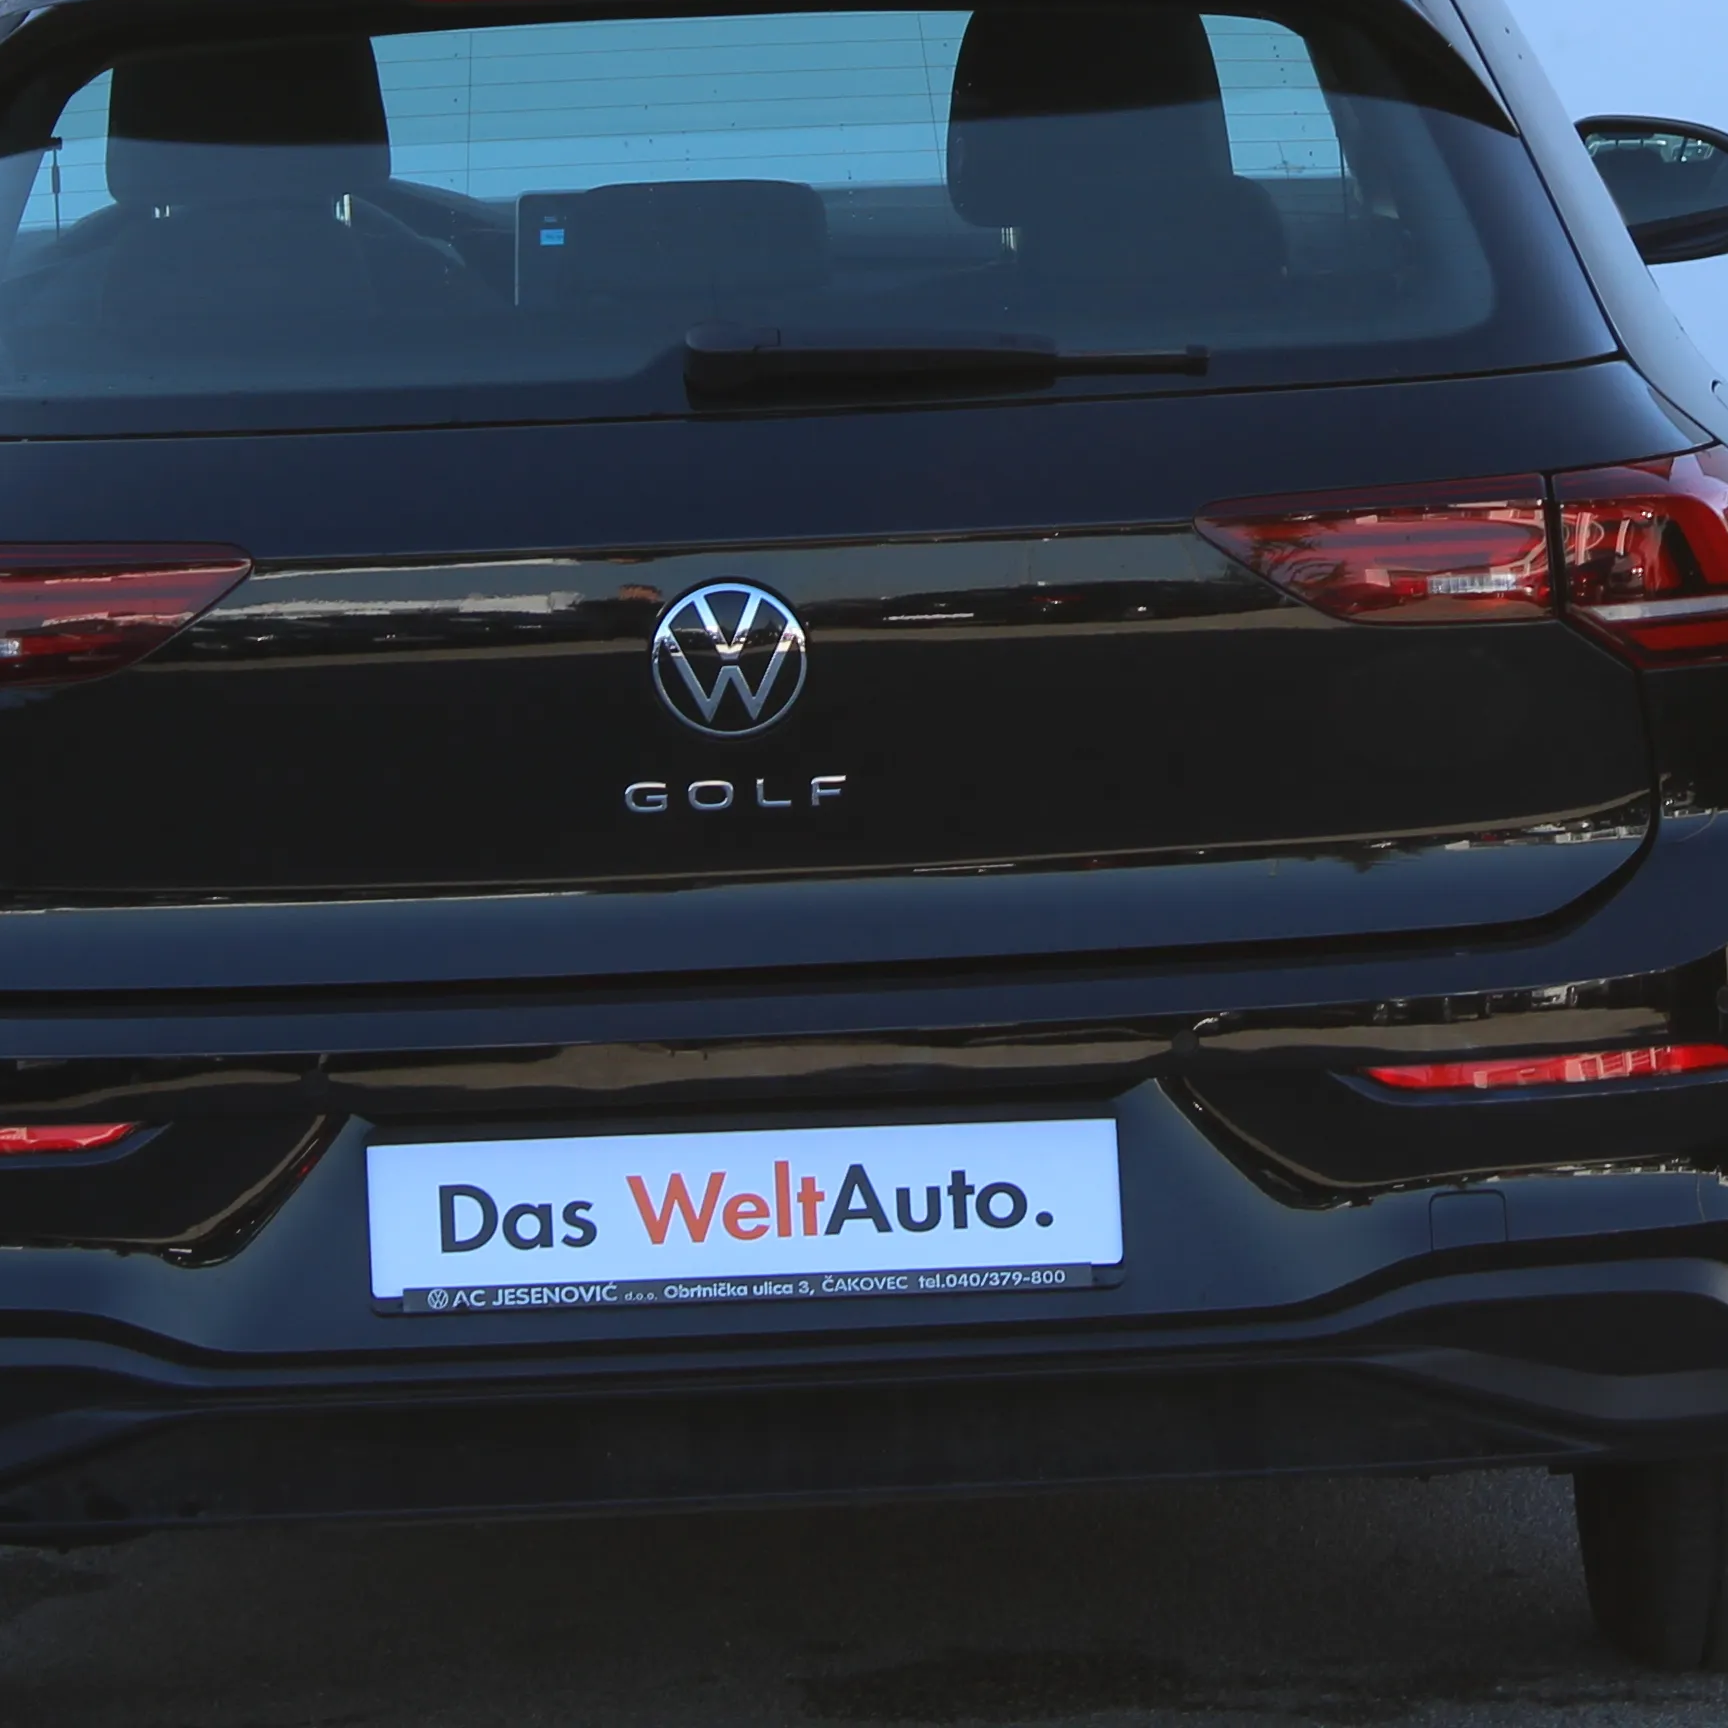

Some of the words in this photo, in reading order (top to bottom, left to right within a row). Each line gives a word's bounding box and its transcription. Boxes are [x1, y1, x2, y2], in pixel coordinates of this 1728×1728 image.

[652, 582, 808, 737] VW
[625, 775, 847, 813] GOLF
[438, 1184, 597, 1254] Das
[626, 1160, 1054, 1245] WeltAuto.
[452, 1289, 487, 1308] AC
[492, 1281, 618, 1306] JESENOVIĆ
[624, 1290, 658, 1302] d.o.o.
[663, 1281, 748, 1300] Obrtnička
[753, 1280, 794, 1296] ulica
[798, 1279, 816, 1297] 3,
[821, 1274, 909, 1293] ČAKOVEC
